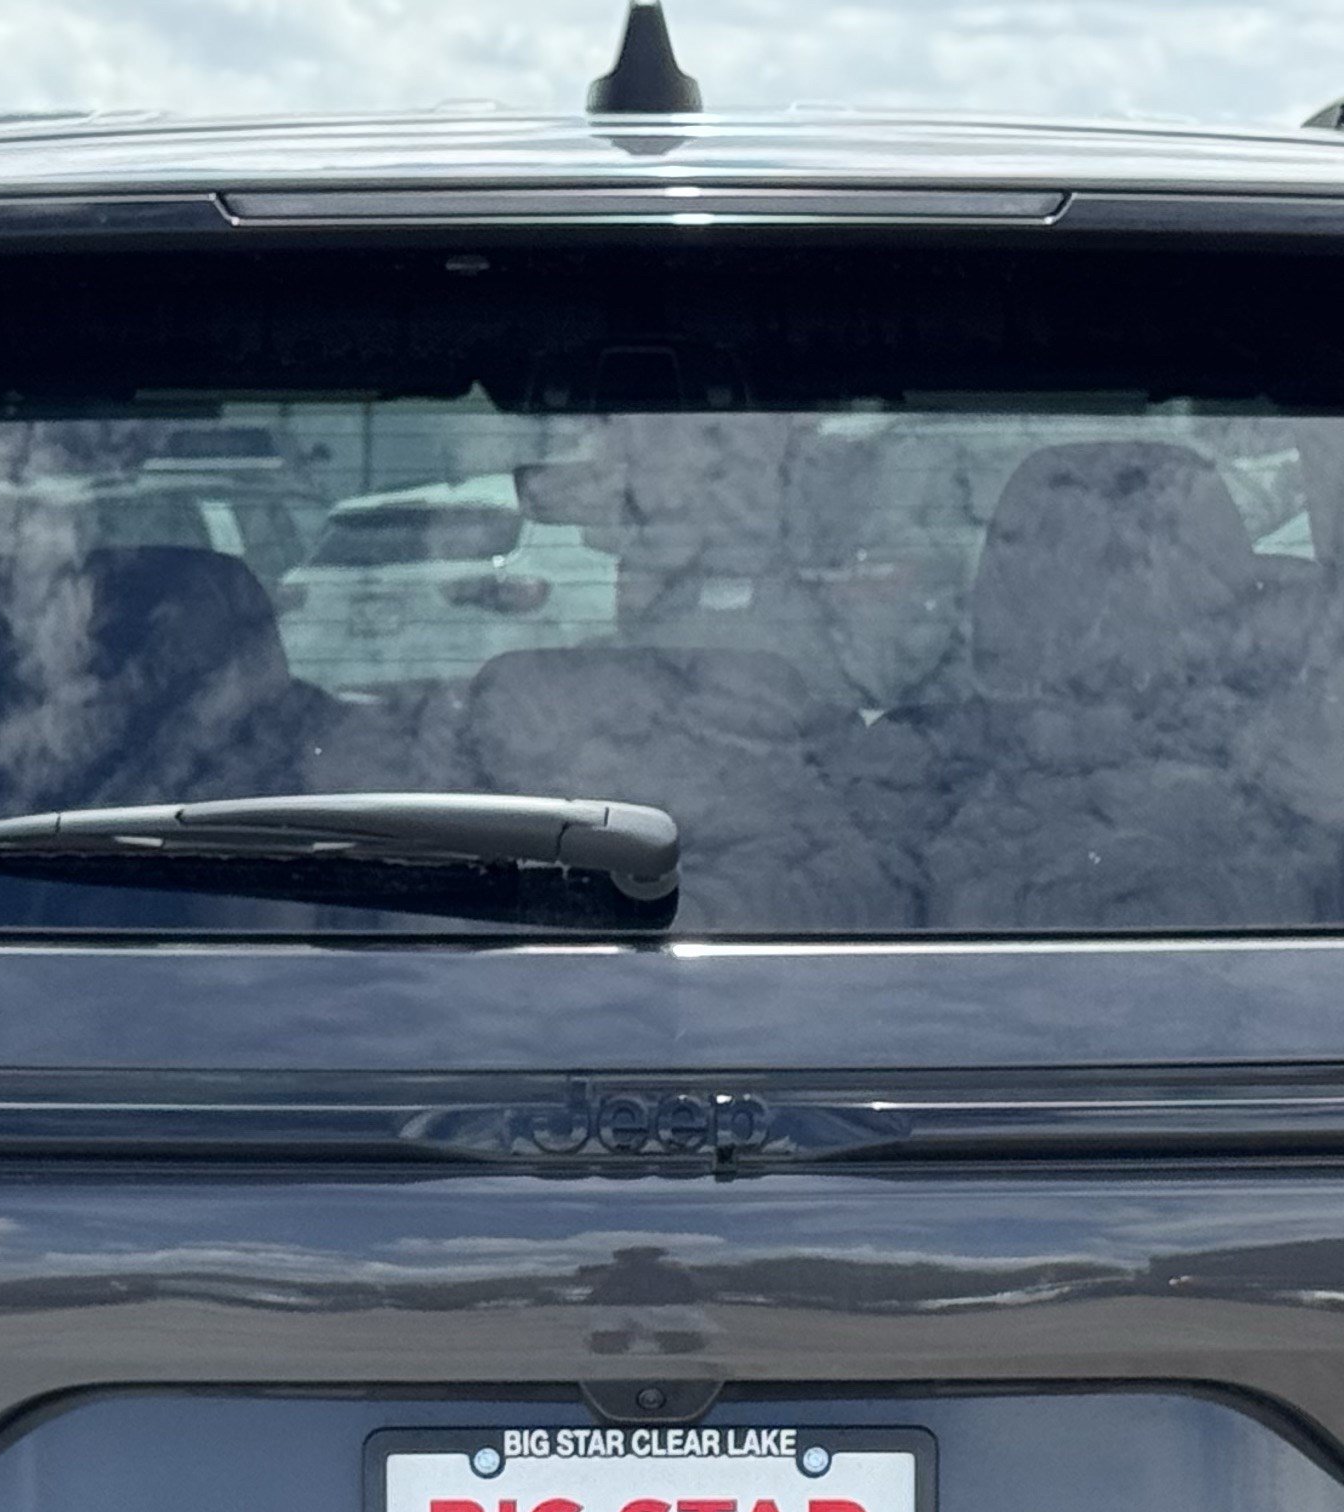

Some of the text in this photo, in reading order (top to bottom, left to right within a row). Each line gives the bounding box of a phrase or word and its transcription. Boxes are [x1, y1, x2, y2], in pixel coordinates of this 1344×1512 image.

[530, 1076, 770, 1178] Jeep
[503, 1429, 797, 1457] BIG STAR CLEAR LAKE
